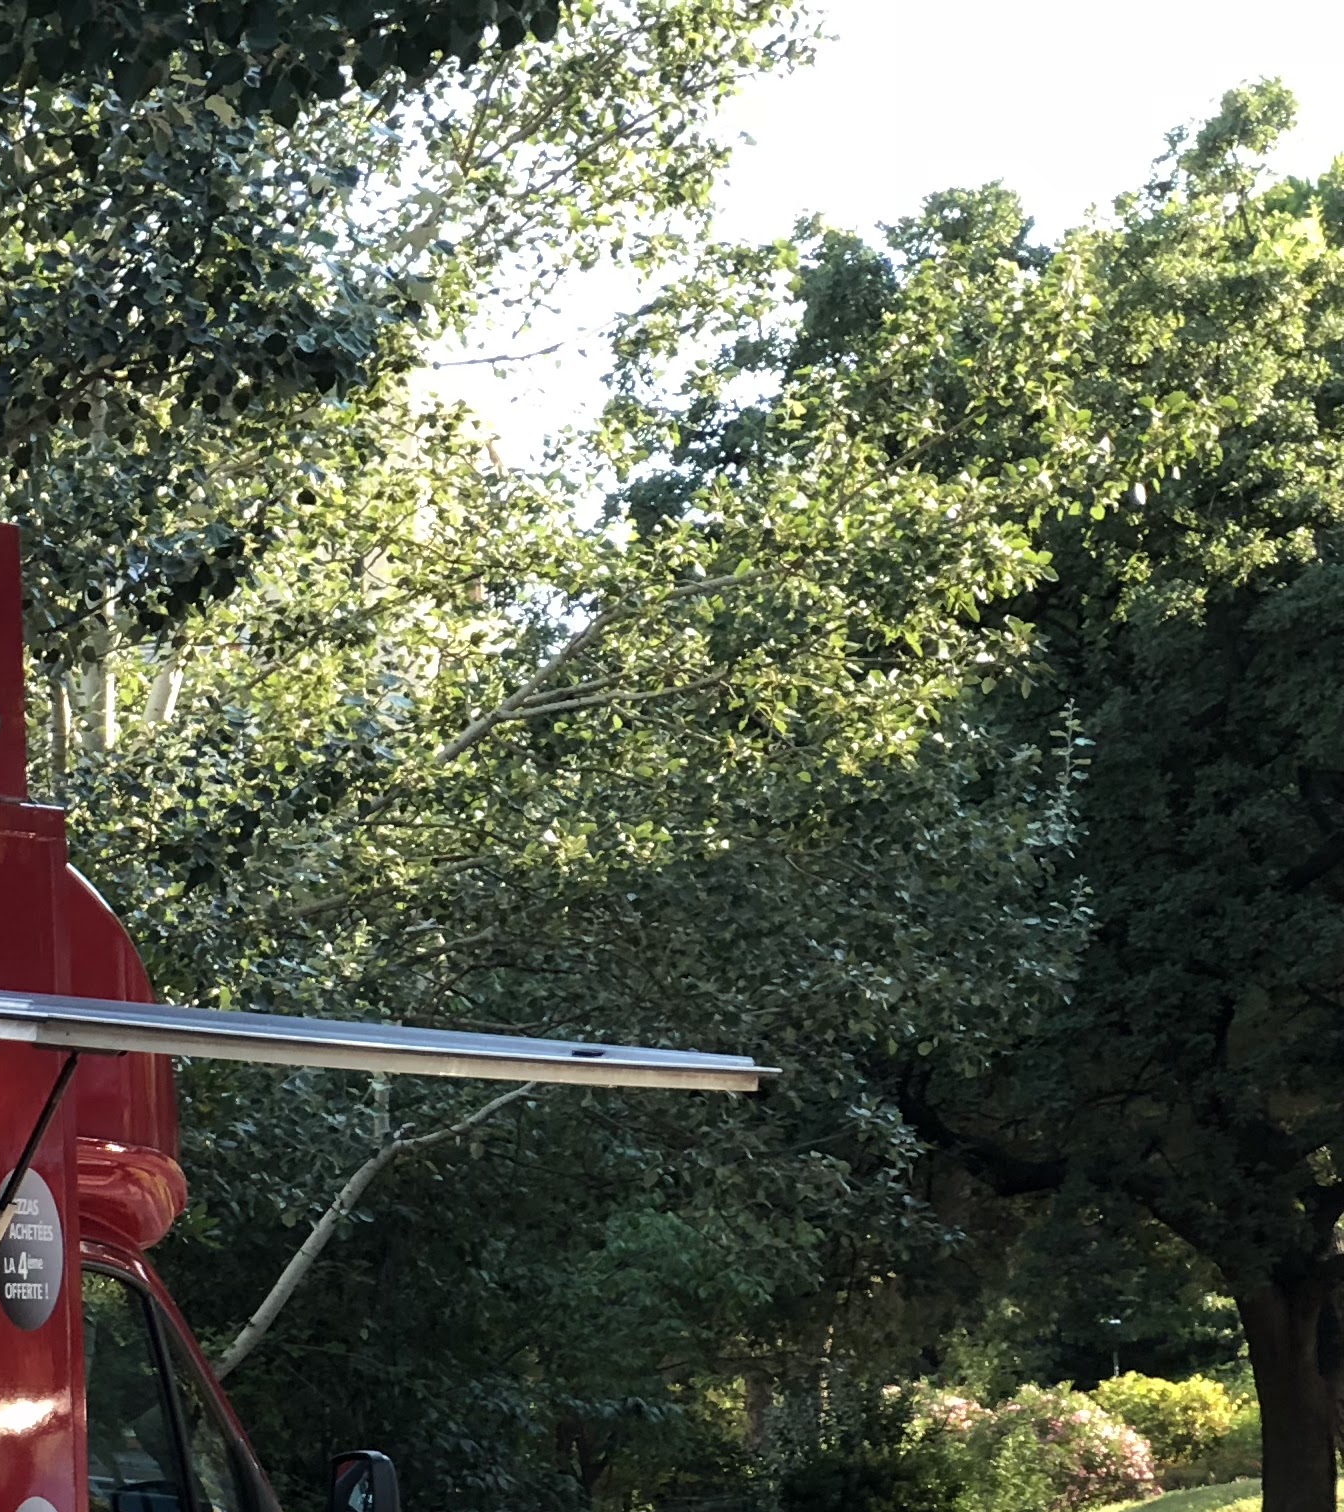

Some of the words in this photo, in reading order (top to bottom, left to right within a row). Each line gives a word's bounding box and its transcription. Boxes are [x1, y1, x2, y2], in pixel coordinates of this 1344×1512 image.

[9, 1220, 54, 1241] ACHETÉES
[3, 1257, 16, 1274] LA
[4, 1282, 43, 1300] OFFERTE
